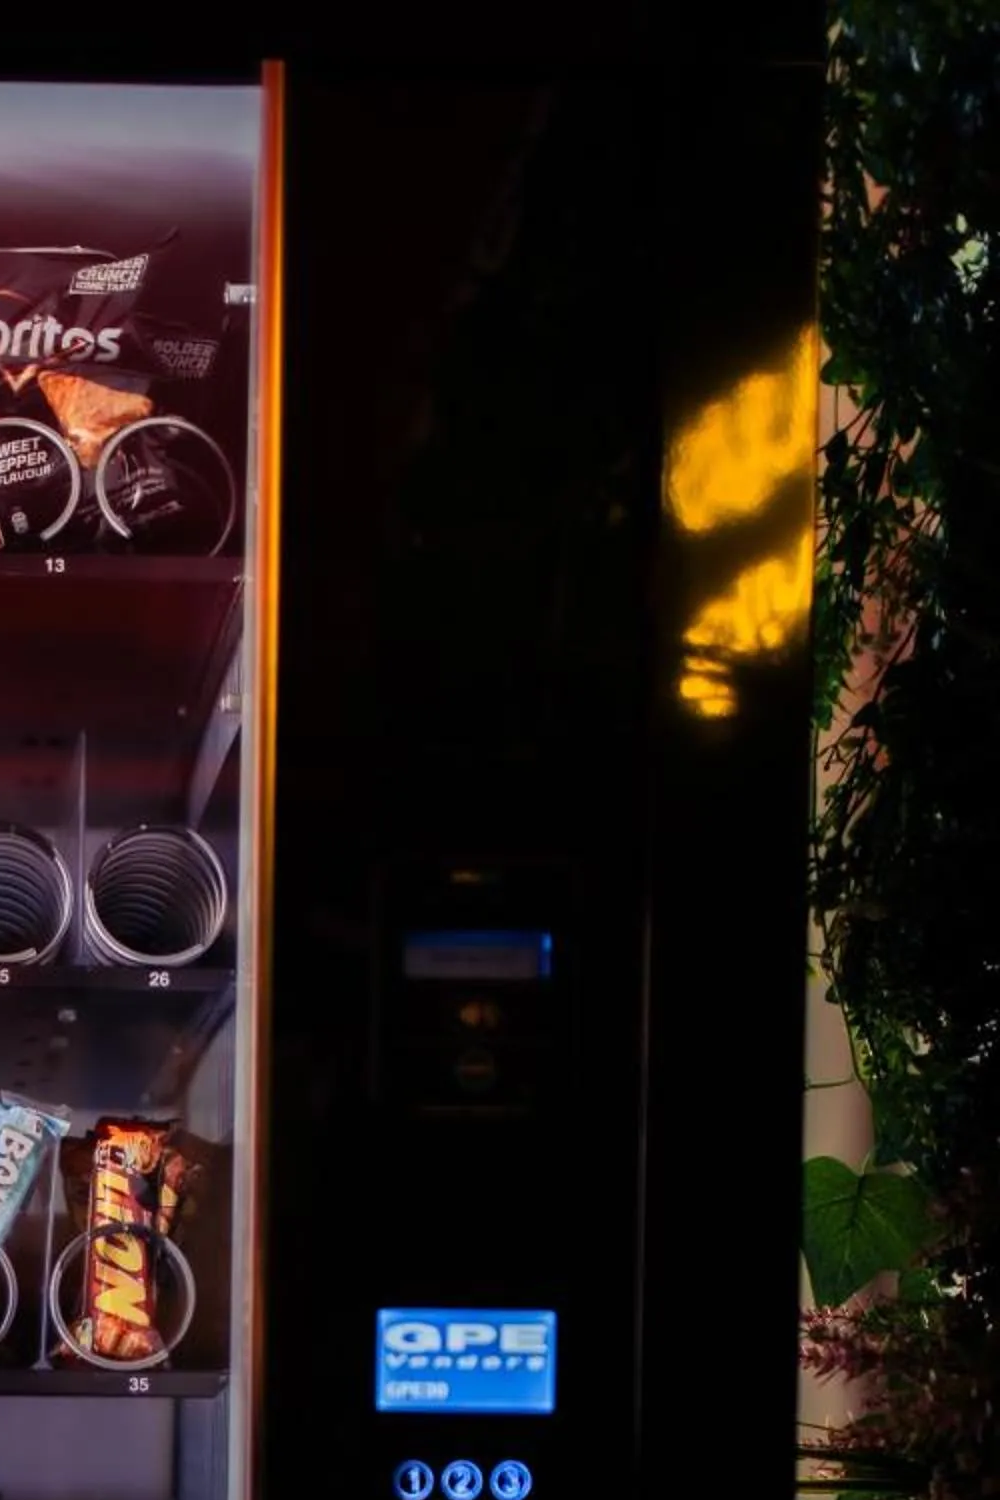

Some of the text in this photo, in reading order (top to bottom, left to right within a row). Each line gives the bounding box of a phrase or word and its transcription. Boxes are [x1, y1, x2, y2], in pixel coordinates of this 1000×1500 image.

[45, 557, 65, 573] 13
[149, 971, 170, 987] 26
[94, 1170, 152, 1328] LION
[129, 1377, 150, 1392] 35
